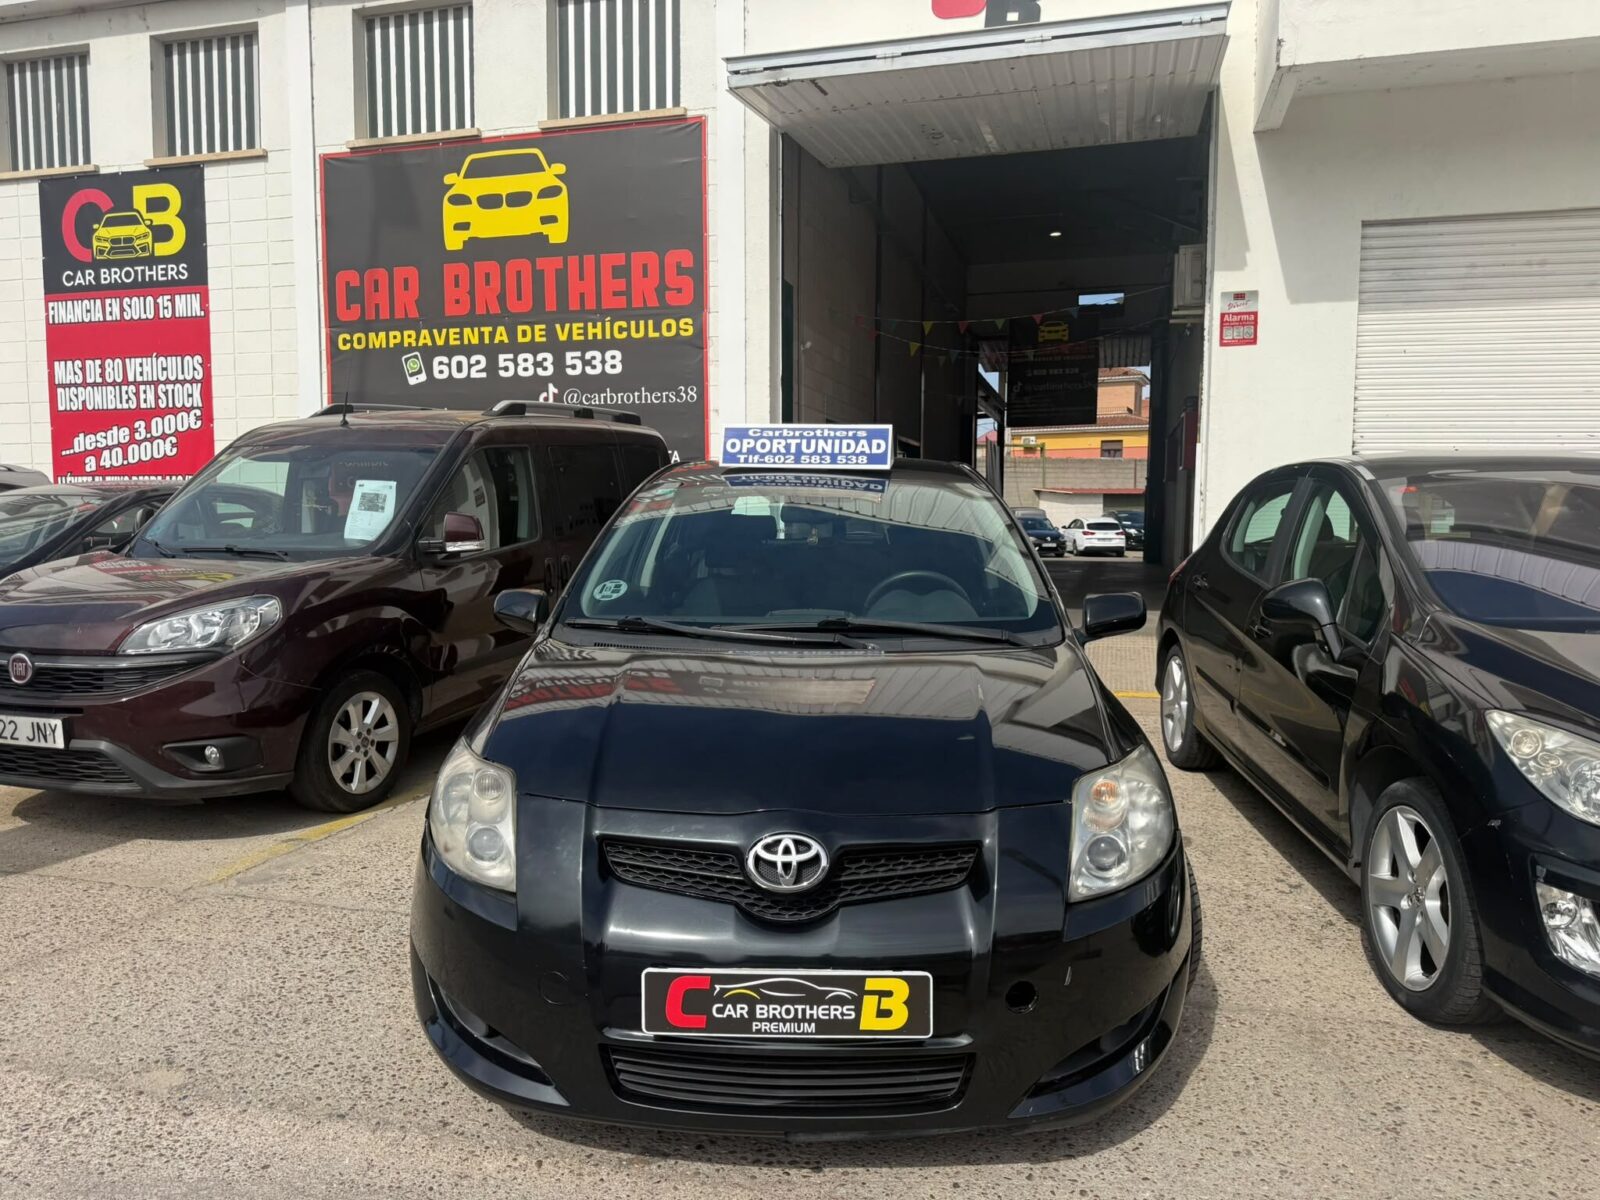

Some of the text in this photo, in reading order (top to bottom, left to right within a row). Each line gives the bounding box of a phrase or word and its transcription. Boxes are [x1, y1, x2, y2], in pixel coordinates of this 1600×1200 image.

[133, 183, 186, 256] B
[62, 263, 188, 287] CAR BROTHERS
[335, 249, 694, 321] CAR BROTHERS
[48, 293, 205, 324] FINANCIA EN SOLO 15 MIN.
[1223, 314, 1255, 322] Alarma
[338, 316, 694, 351] COMPRAVENTA DE VEHÍCULOS
[53, 352, 204, 385] MAS DE 80 VEHÍCULOS
[433, 350, 623, 380] 602 583 538
[57, 383, 203, 411] DISPONIBLES EN STOCK
[563, 385, 698, 405] @carbrothers38
[61, 409, 202, 456] ...desde 3.000€
[725, 438, 886, 455] OPORTUNIDAD
[748, 428, 868, 437] Carbrothers
[85, 436, 178, 472] a 40.000€
[800, 455, 831, 464] 583
[836, 455, 868, 465] 538
[13, 662, 26, 677] FIAT
[26, 721, 58, 744] JNY
[665, 975, 909, 1031] C CAR BROTHERS B
[752, 1022, 816, 1034] PREMIUM
